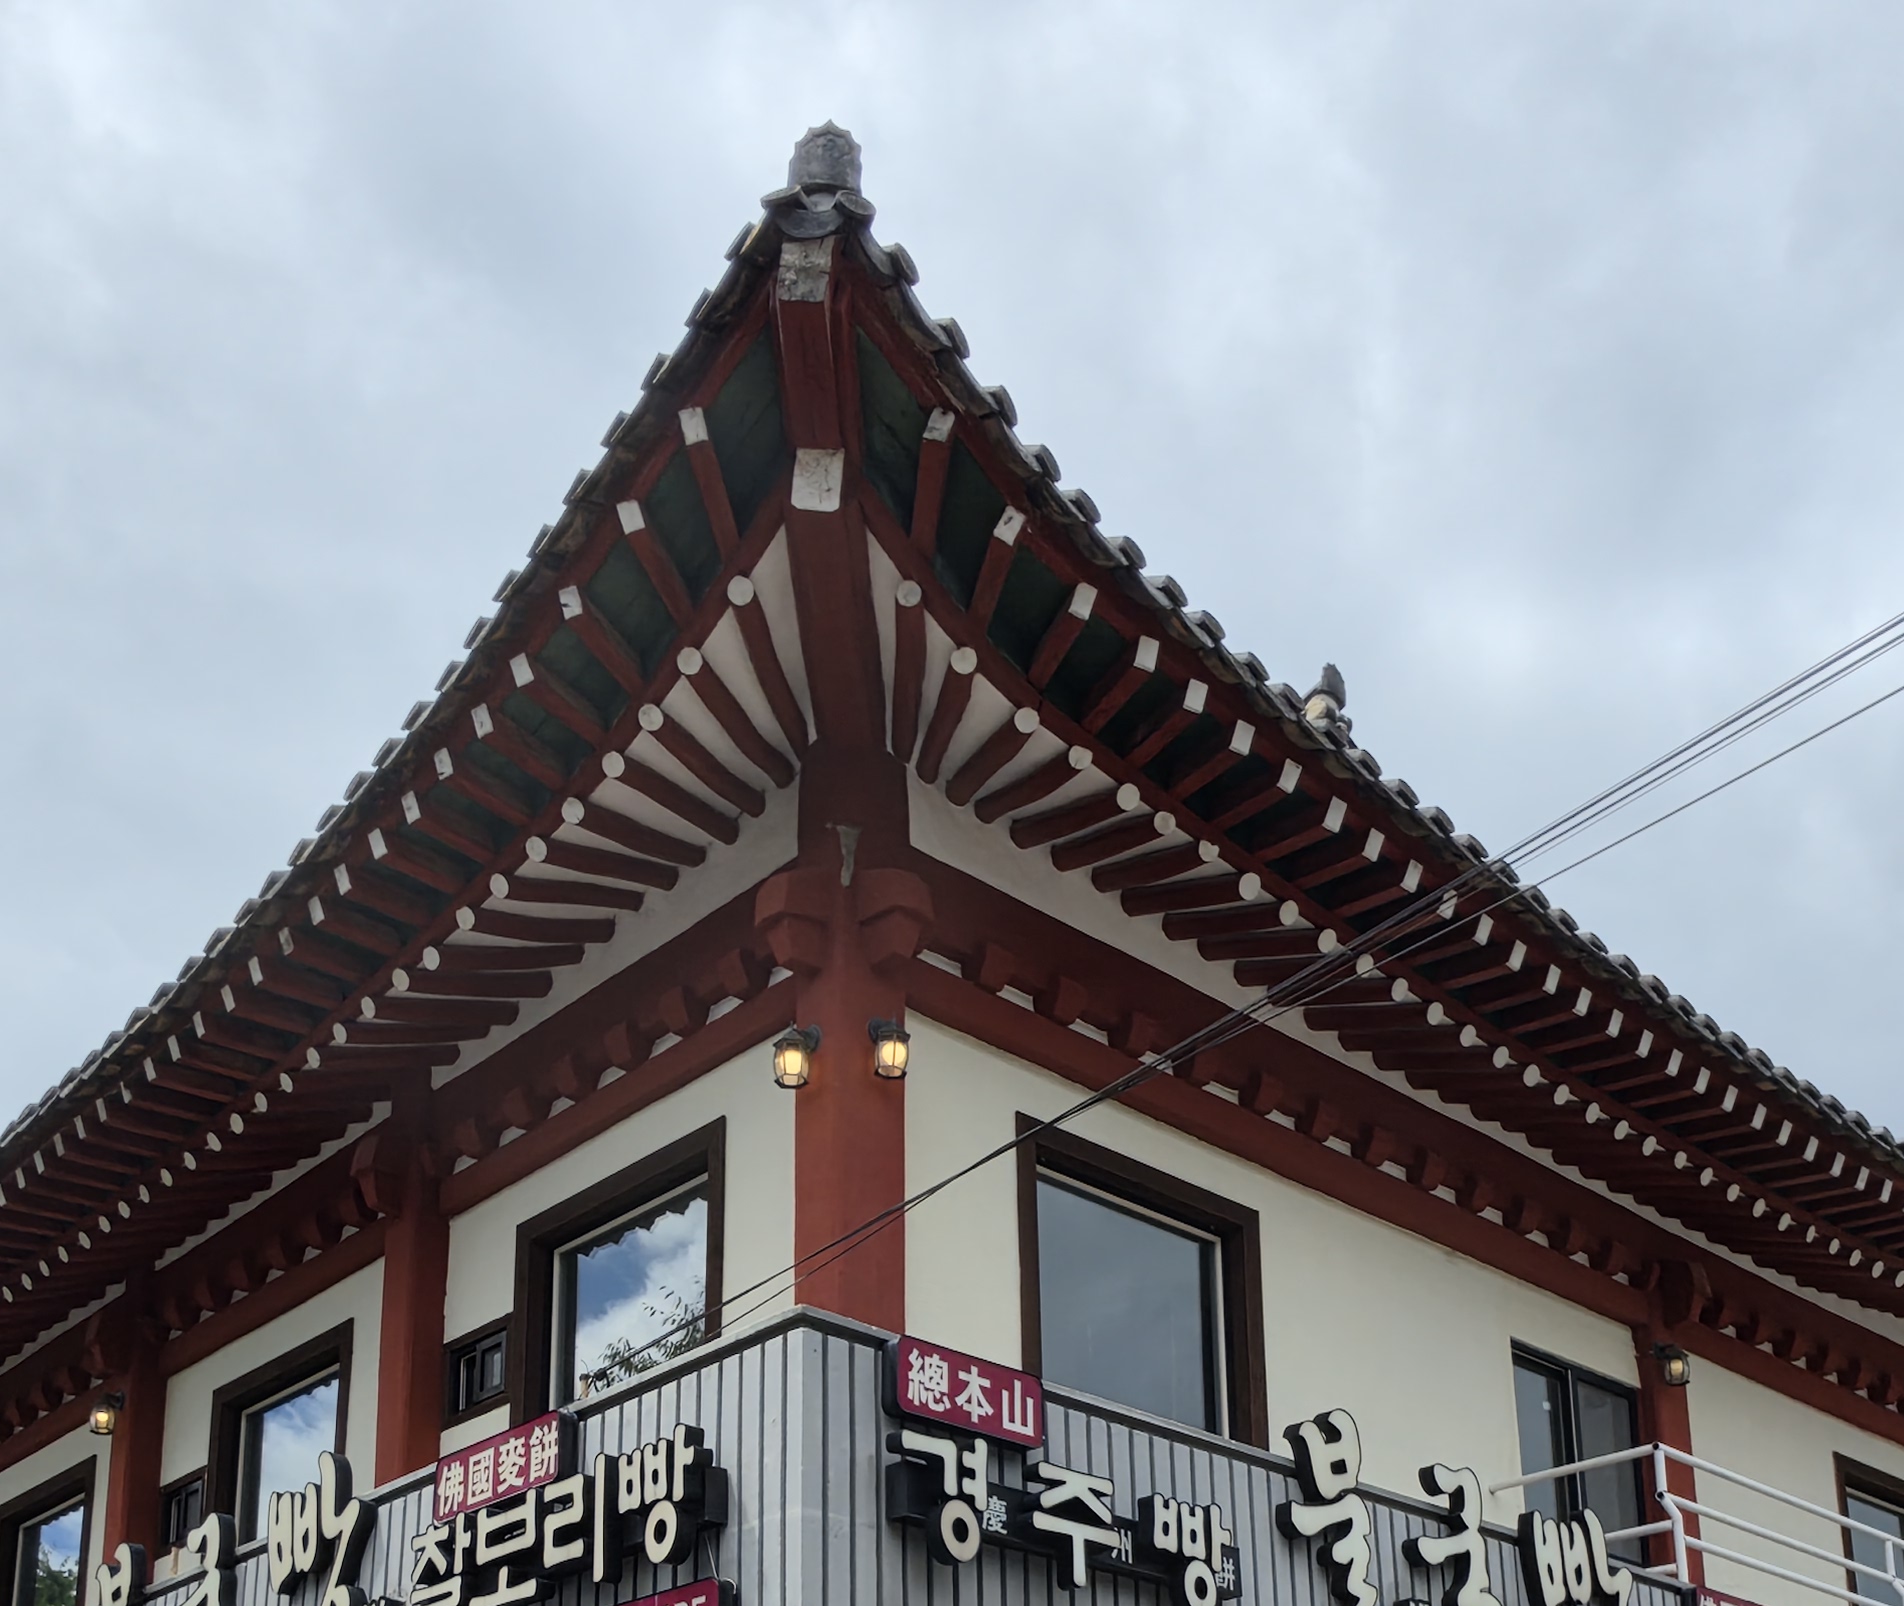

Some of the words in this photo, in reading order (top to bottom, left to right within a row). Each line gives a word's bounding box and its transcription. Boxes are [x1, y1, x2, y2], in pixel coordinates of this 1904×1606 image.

[907, 1347, 1035, 1437] 總本山
[437, 1420, 559, 1516] 佛國麥餅
